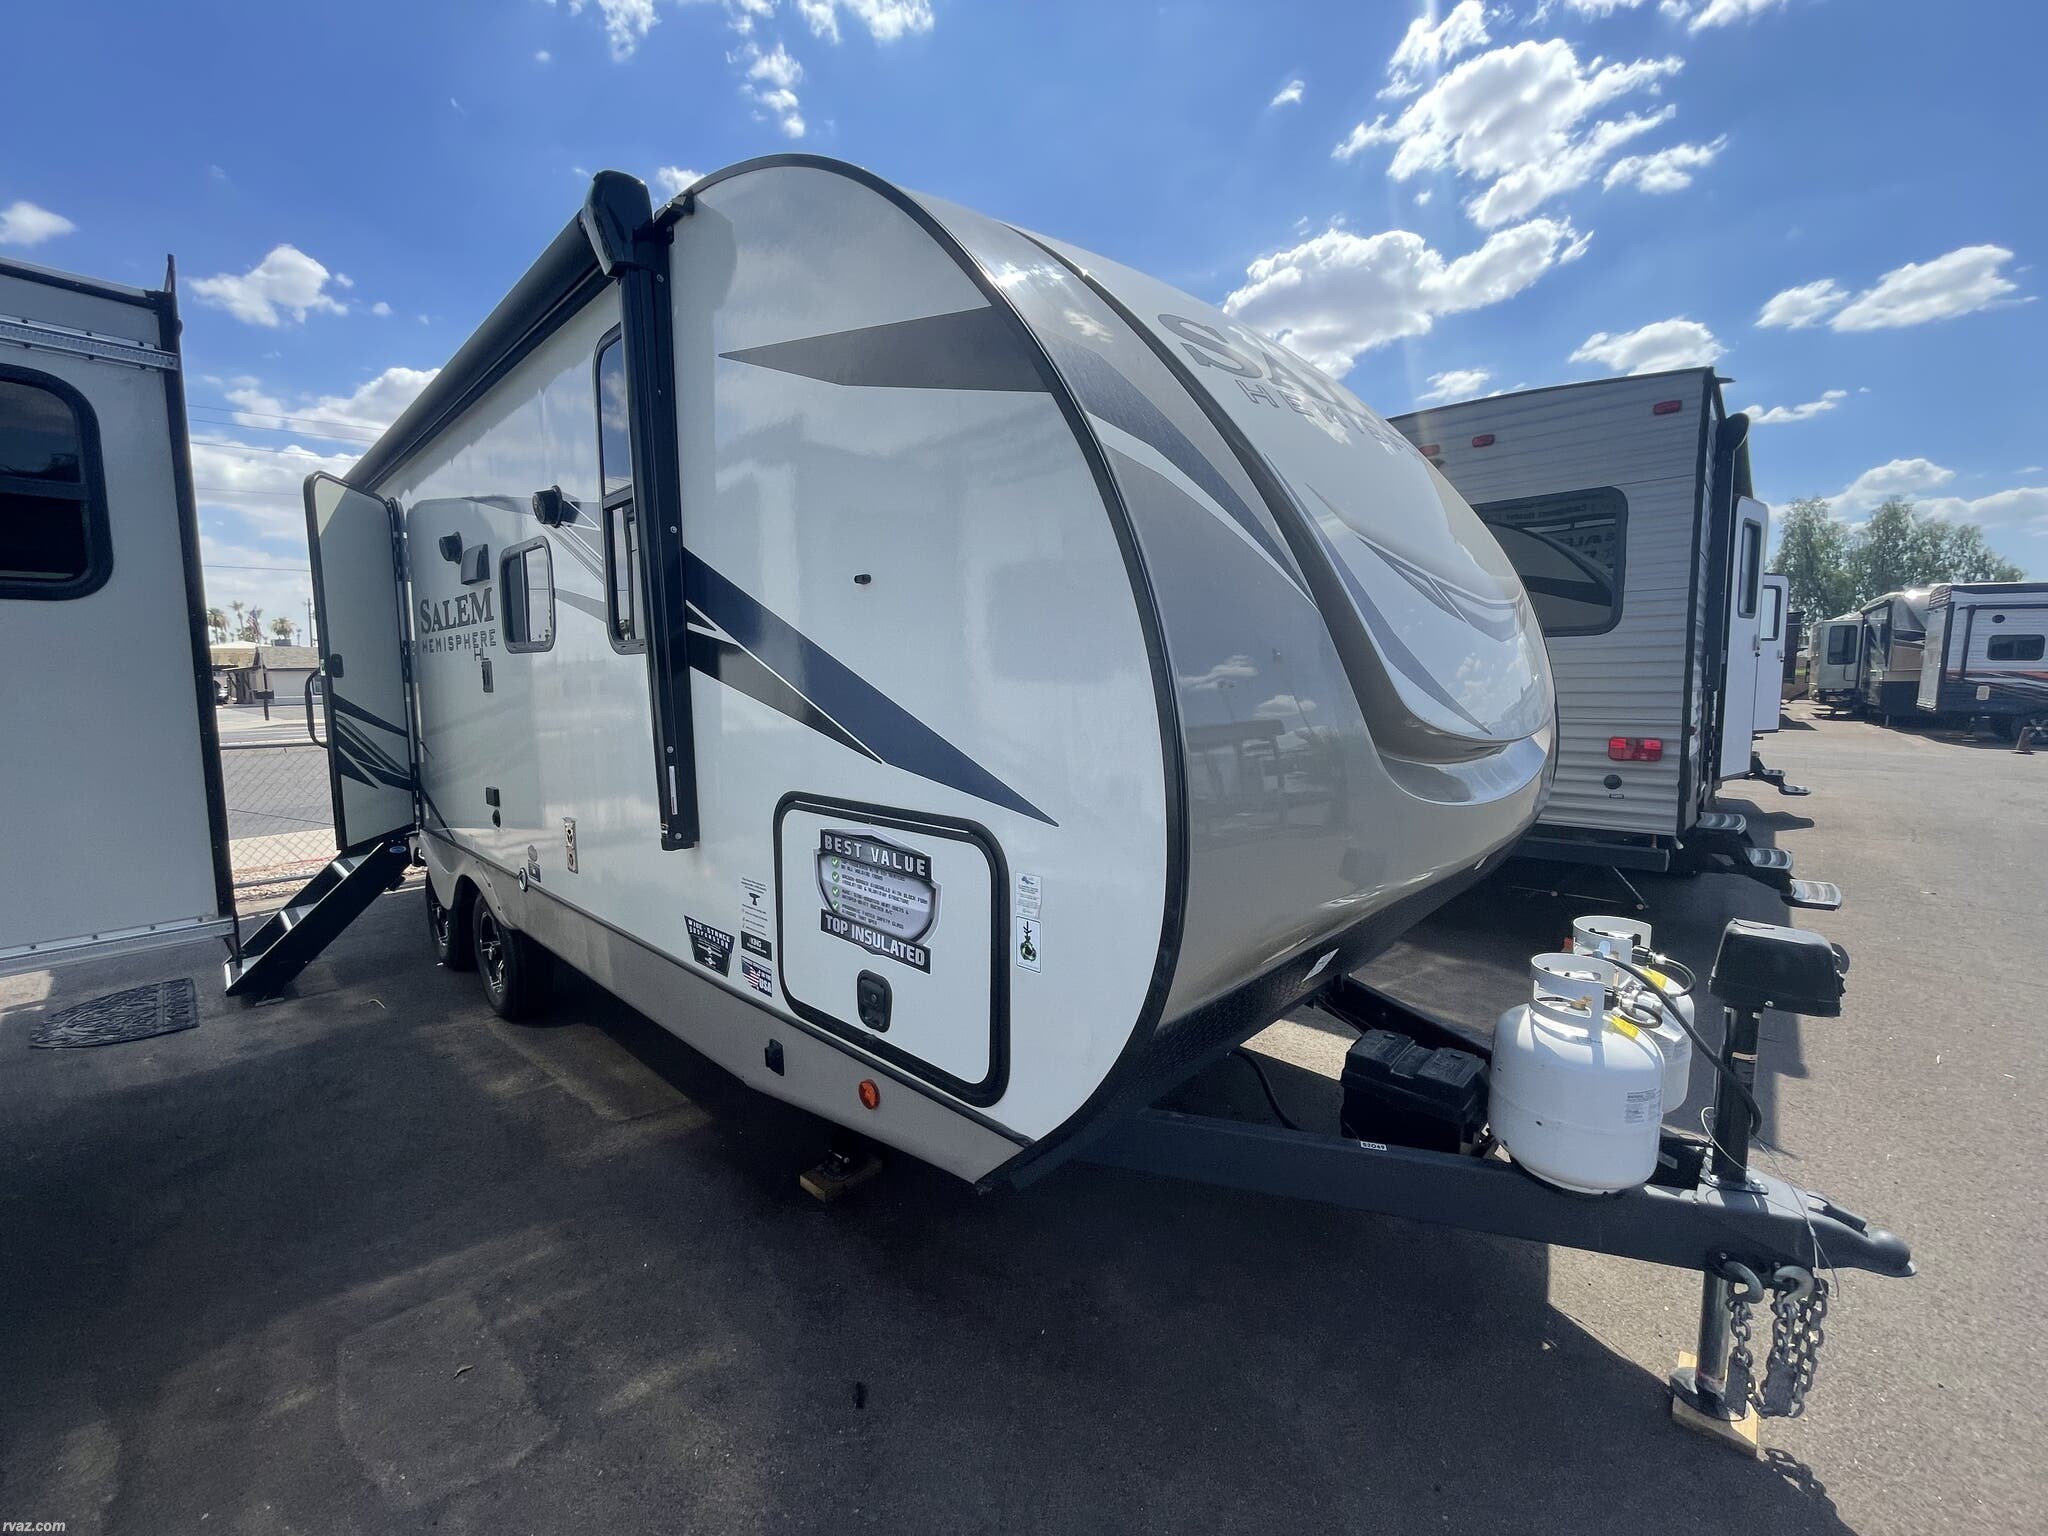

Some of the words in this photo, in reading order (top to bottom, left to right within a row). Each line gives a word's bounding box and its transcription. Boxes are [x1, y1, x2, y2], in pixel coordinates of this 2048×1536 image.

[421, 587, 495, 634] SALEM
[422, 628, 497, 653] HEMISPHERE
[473, 648, 490, 661] HL
[824, 834, 862, 858] BEST
[871, 846, 926, 876] VALUE
[825, 914, 848, 935] TOP
[851, 923, 926, 967] INSULATED
[759, 977, 772, 993] USA
